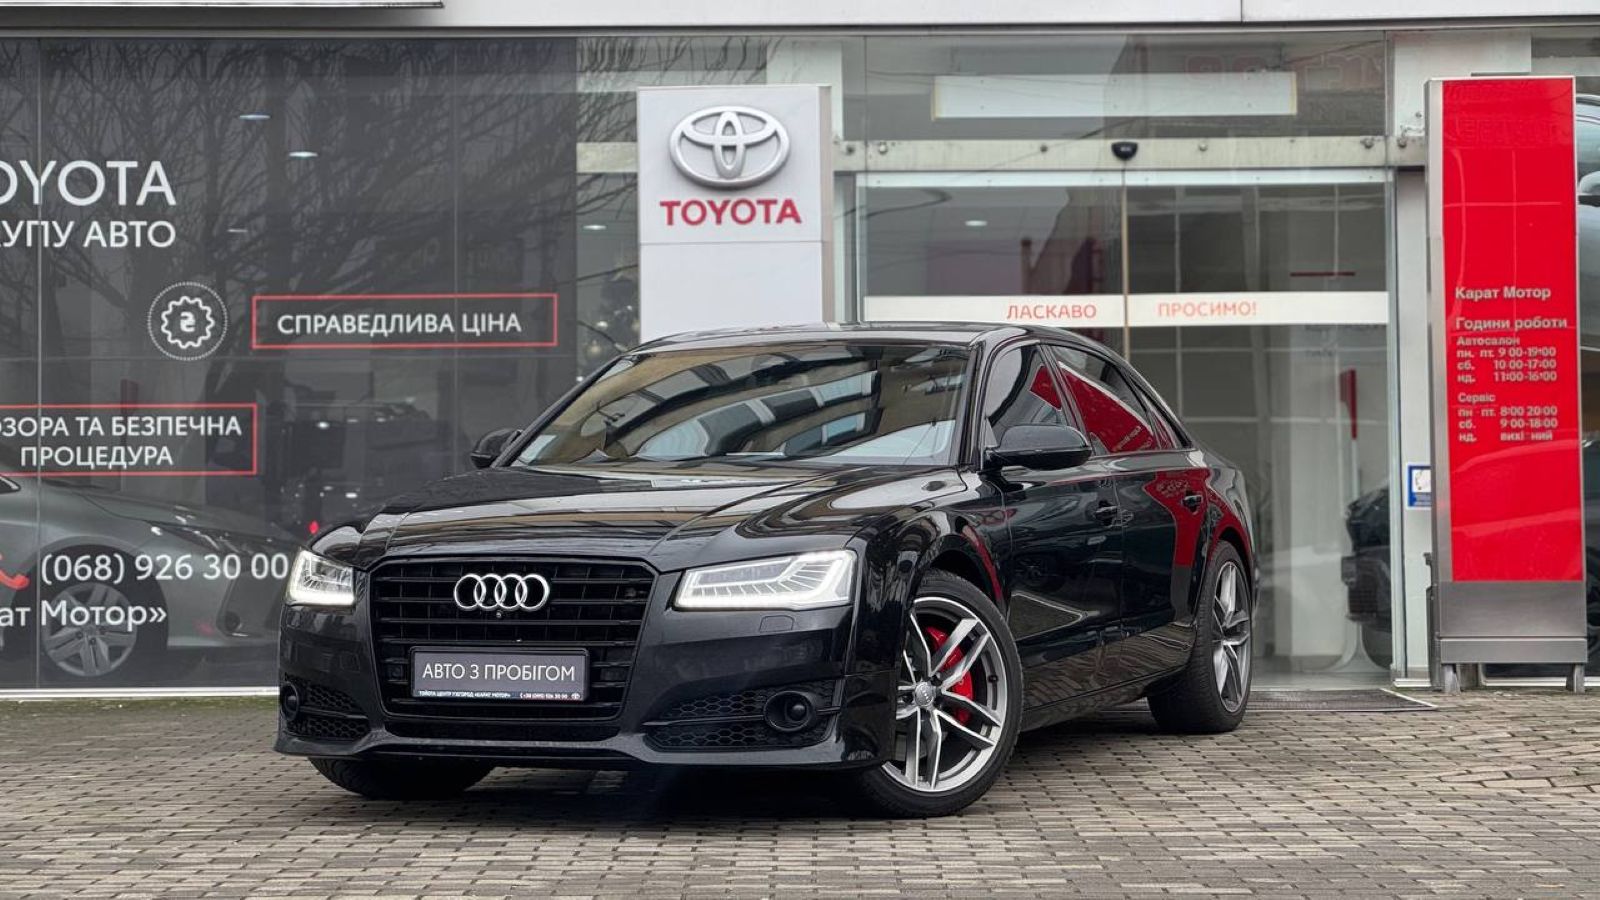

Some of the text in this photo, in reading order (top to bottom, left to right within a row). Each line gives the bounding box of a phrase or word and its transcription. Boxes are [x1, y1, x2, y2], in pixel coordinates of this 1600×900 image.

[660, 198, 801, 226] TOYOTA
[0, 220, 176, 248] УПУ АВТО
[1456, 286, 1552, 301] Карат Мотор
[1007, 303, 1097, 320] ЛАСКАВО
[1156, 301, 1258, 318] ПРОСИМО!
[277, 313, 522, 338] СПРАВЕДЛИВА ЦІНА
[1456, 316, 1568, 332] Години роботи
[1456, 336, 1520, 346] Автосалон
[1457, 360, 1475, 370] сб.
[1458, 392, 1496, 404] Сервіс
[0, 416, 242, 437] ЗОРА ТА БЕЗПЕЧНА
[21, 445, 174, 470] ПРОЦЕДУРА
[41, 552, 289, 585] (068) 926 30 00
[41, 600, 167, 635] Мотор»
[422, 663, 466, 680] АВТО
[484, 664, 575, 681] ПРОБІГОМ
